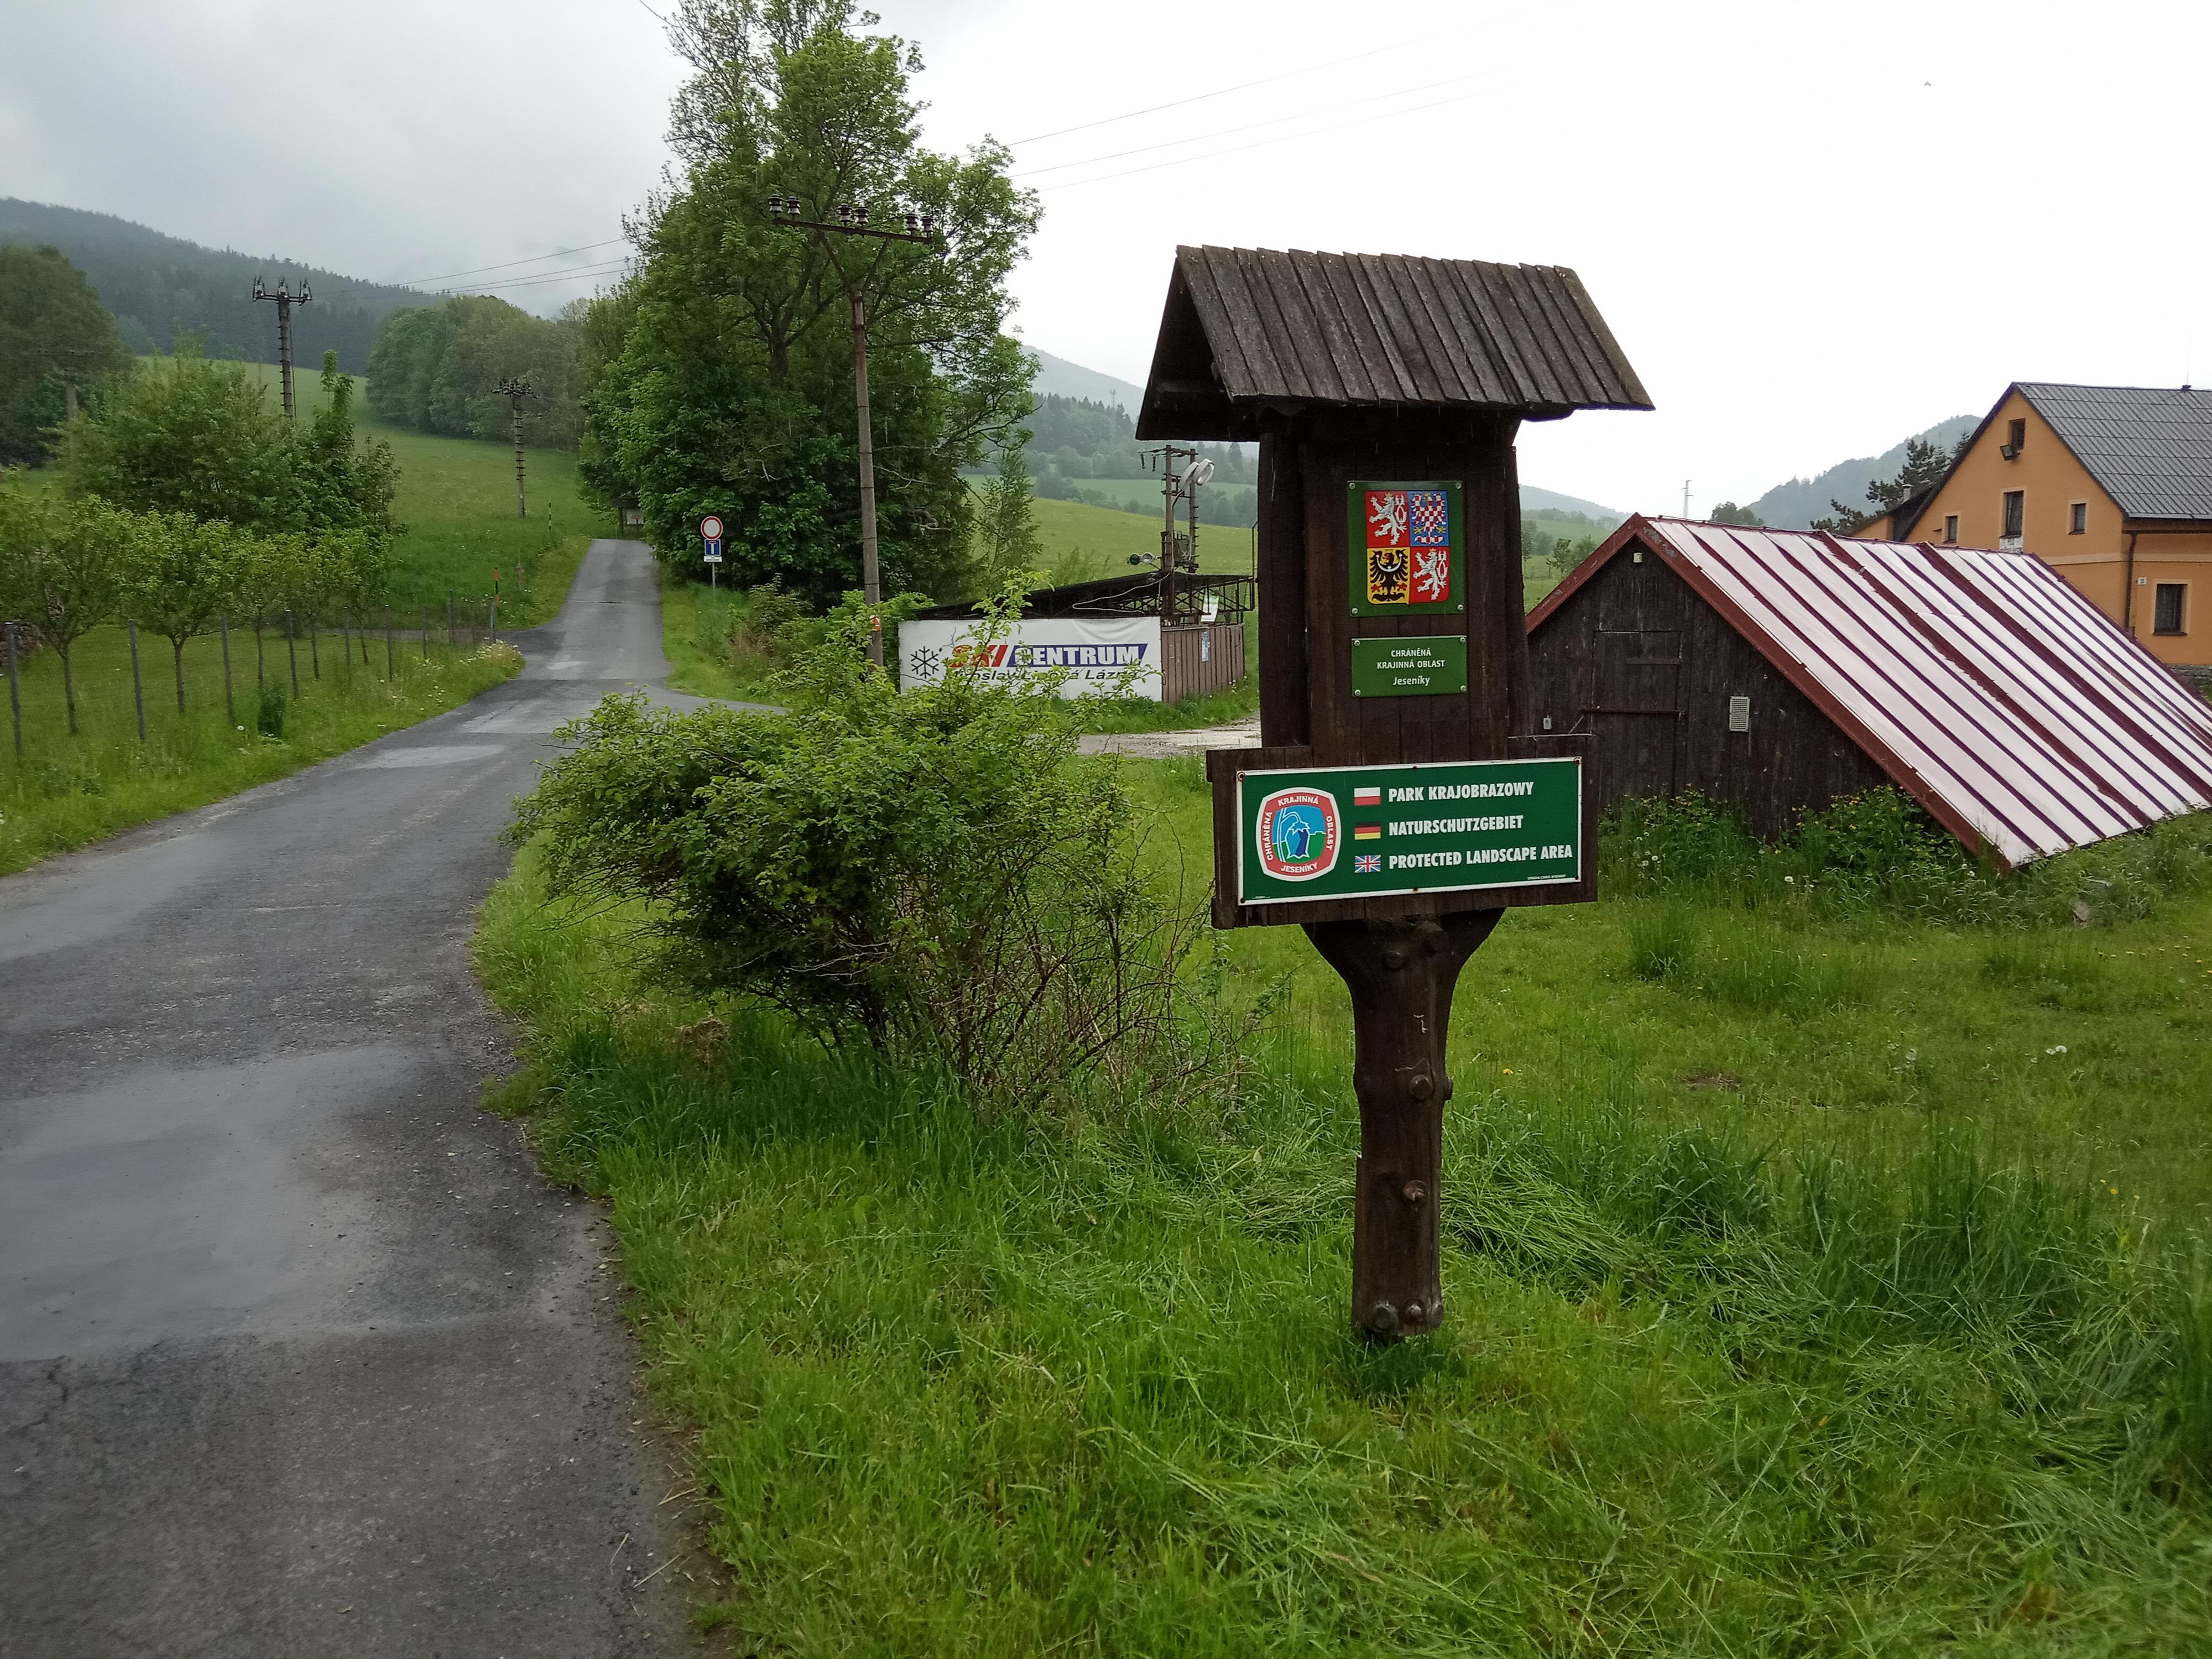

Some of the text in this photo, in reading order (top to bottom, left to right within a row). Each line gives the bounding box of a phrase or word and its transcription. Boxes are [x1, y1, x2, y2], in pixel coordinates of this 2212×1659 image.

[1015, 646, 1140, 665] CENTRUM
[1391, 648, 1431, 657] CHRÁNĚNÁ
[1377, 659, 1446, 669] KRAJINNÁ OBLAST
[1392, 675, 1430, 686] Jeseníky
[1389, 781, 1534, 802] PARK KRAJOBRAZOWY
[1277, 796, 1319, 806] KRAJINNÁ
[1389, 815, 1524, 836] NATURSCHUTZGEBIET
[1262, 811, 1274, 860] CHRÁNĚNÁ
[1389, 844, 1573, 869] PROTECTED LANDSCAPE AREA
[1280, 862, 1318, 873] JESENÍKY
